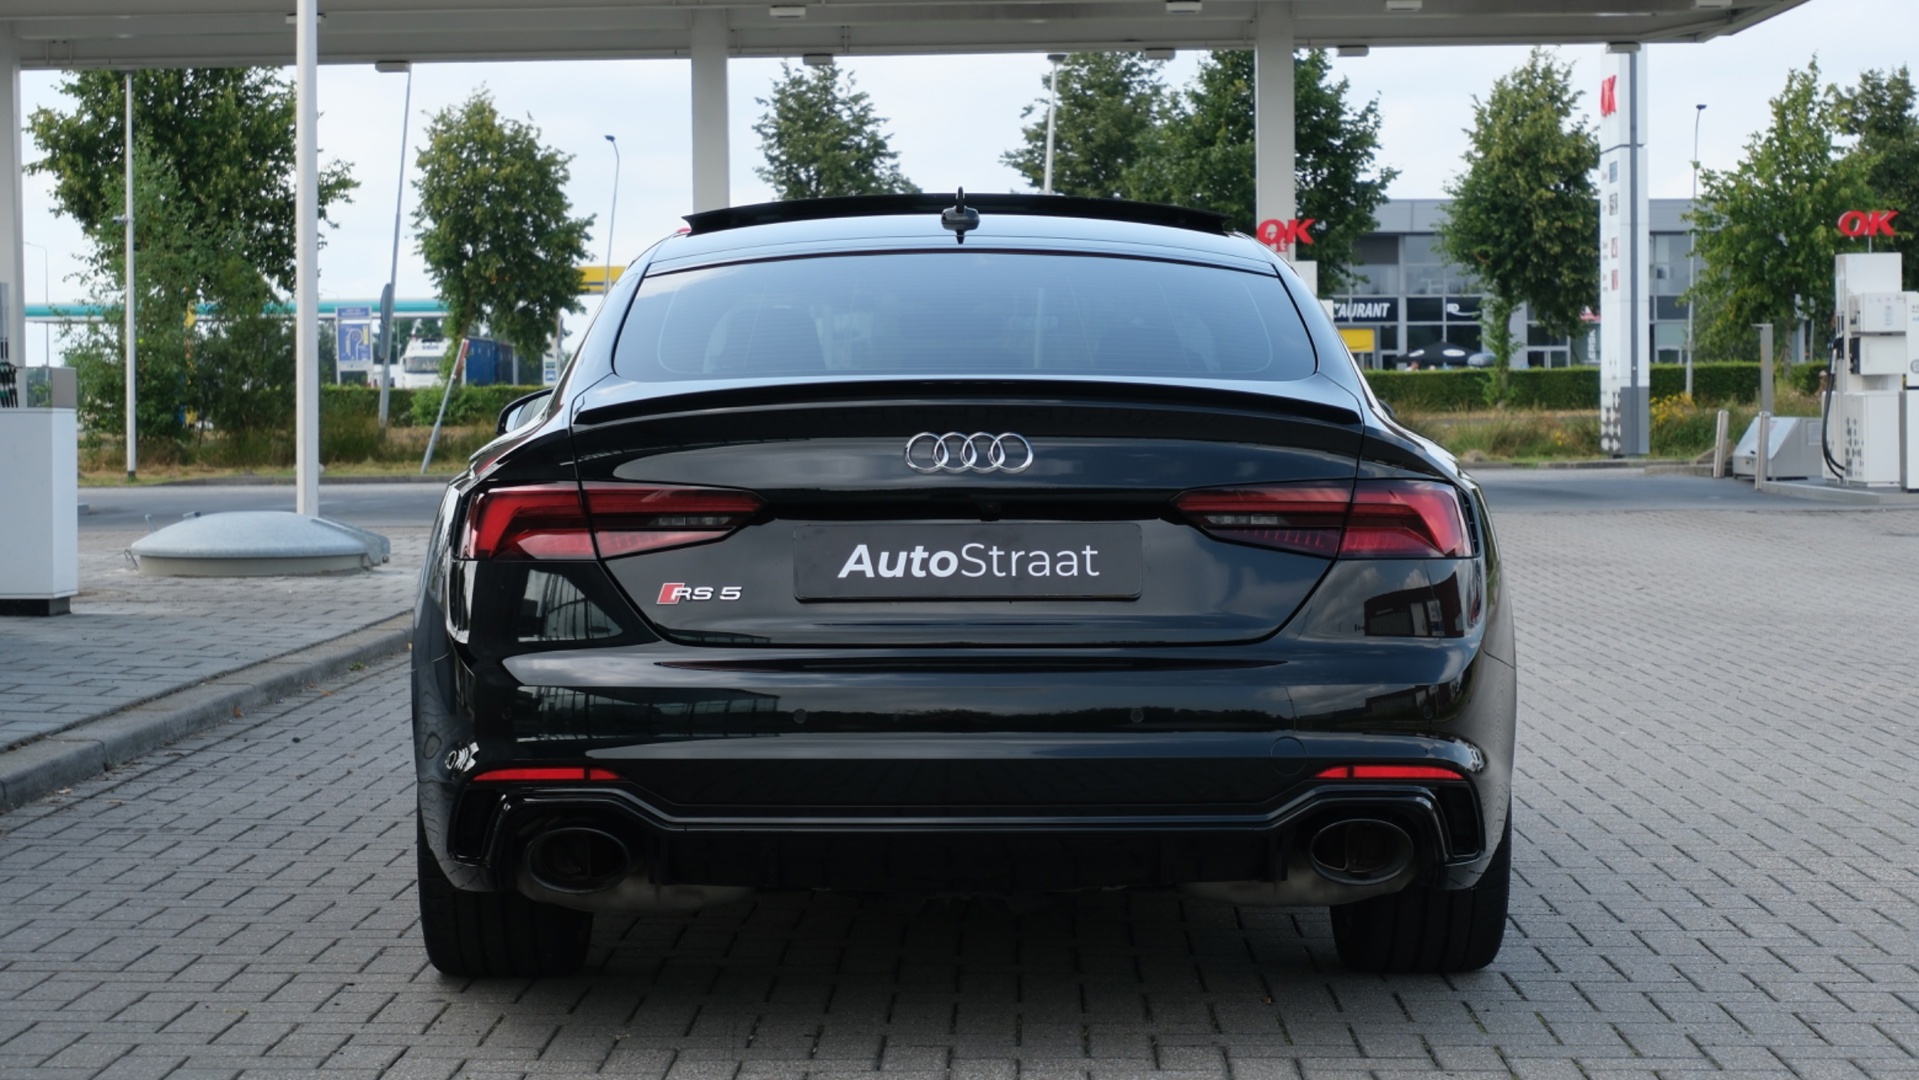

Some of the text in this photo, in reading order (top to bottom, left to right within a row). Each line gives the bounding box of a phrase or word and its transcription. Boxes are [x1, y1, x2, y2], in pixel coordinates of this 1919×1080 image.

[1600, 74, 1617, 118] OK
[1257, 218, 1316, 245] OK
[1838, 210, 1899, 237] OK
[837, 542, 1101, 578] AutoStraat
[670, 585, 743, 602] RS 5
